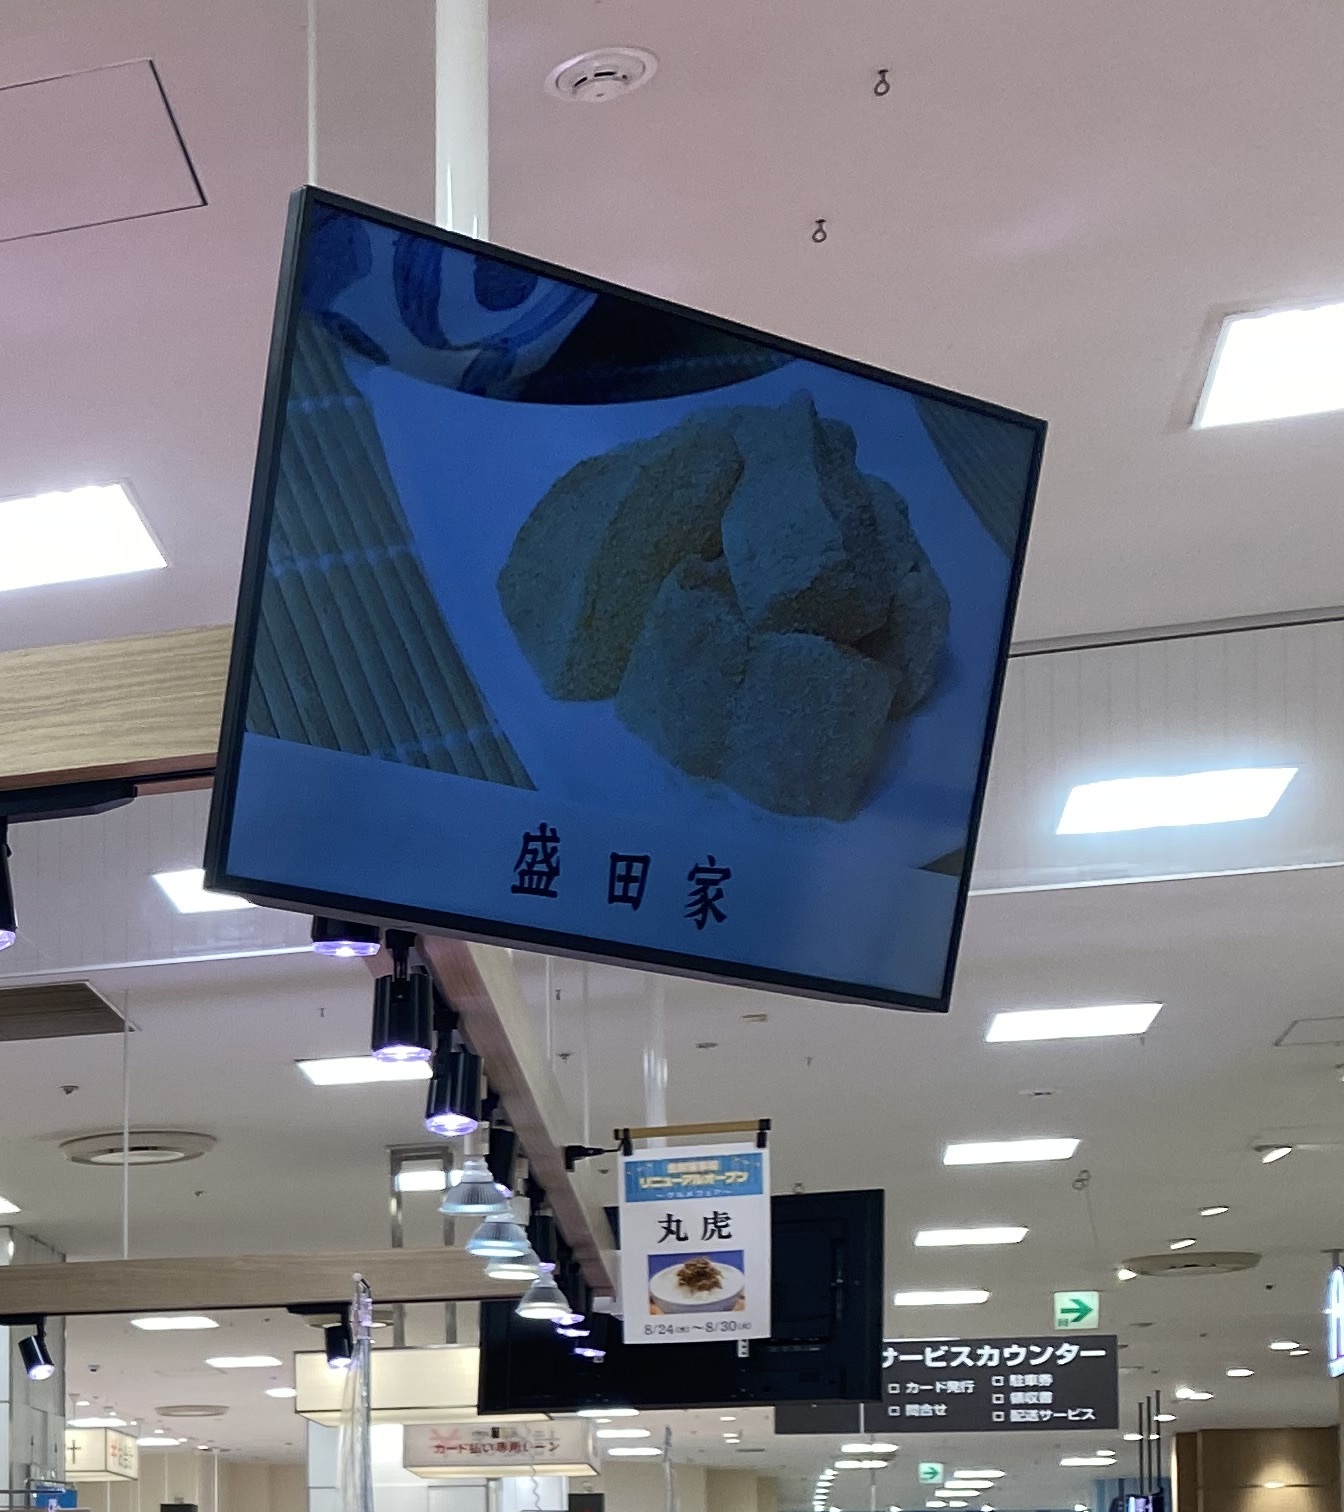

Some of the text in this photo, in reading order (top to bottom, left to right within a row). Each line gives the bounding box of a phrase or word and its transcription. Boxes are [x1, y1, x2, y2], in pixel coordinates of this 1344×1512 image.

[510, 821, 733, 931] 盛田家
[657, 1210, 733, 1244] 丸虎
[905, 1379, 975, 1394] カード発行
